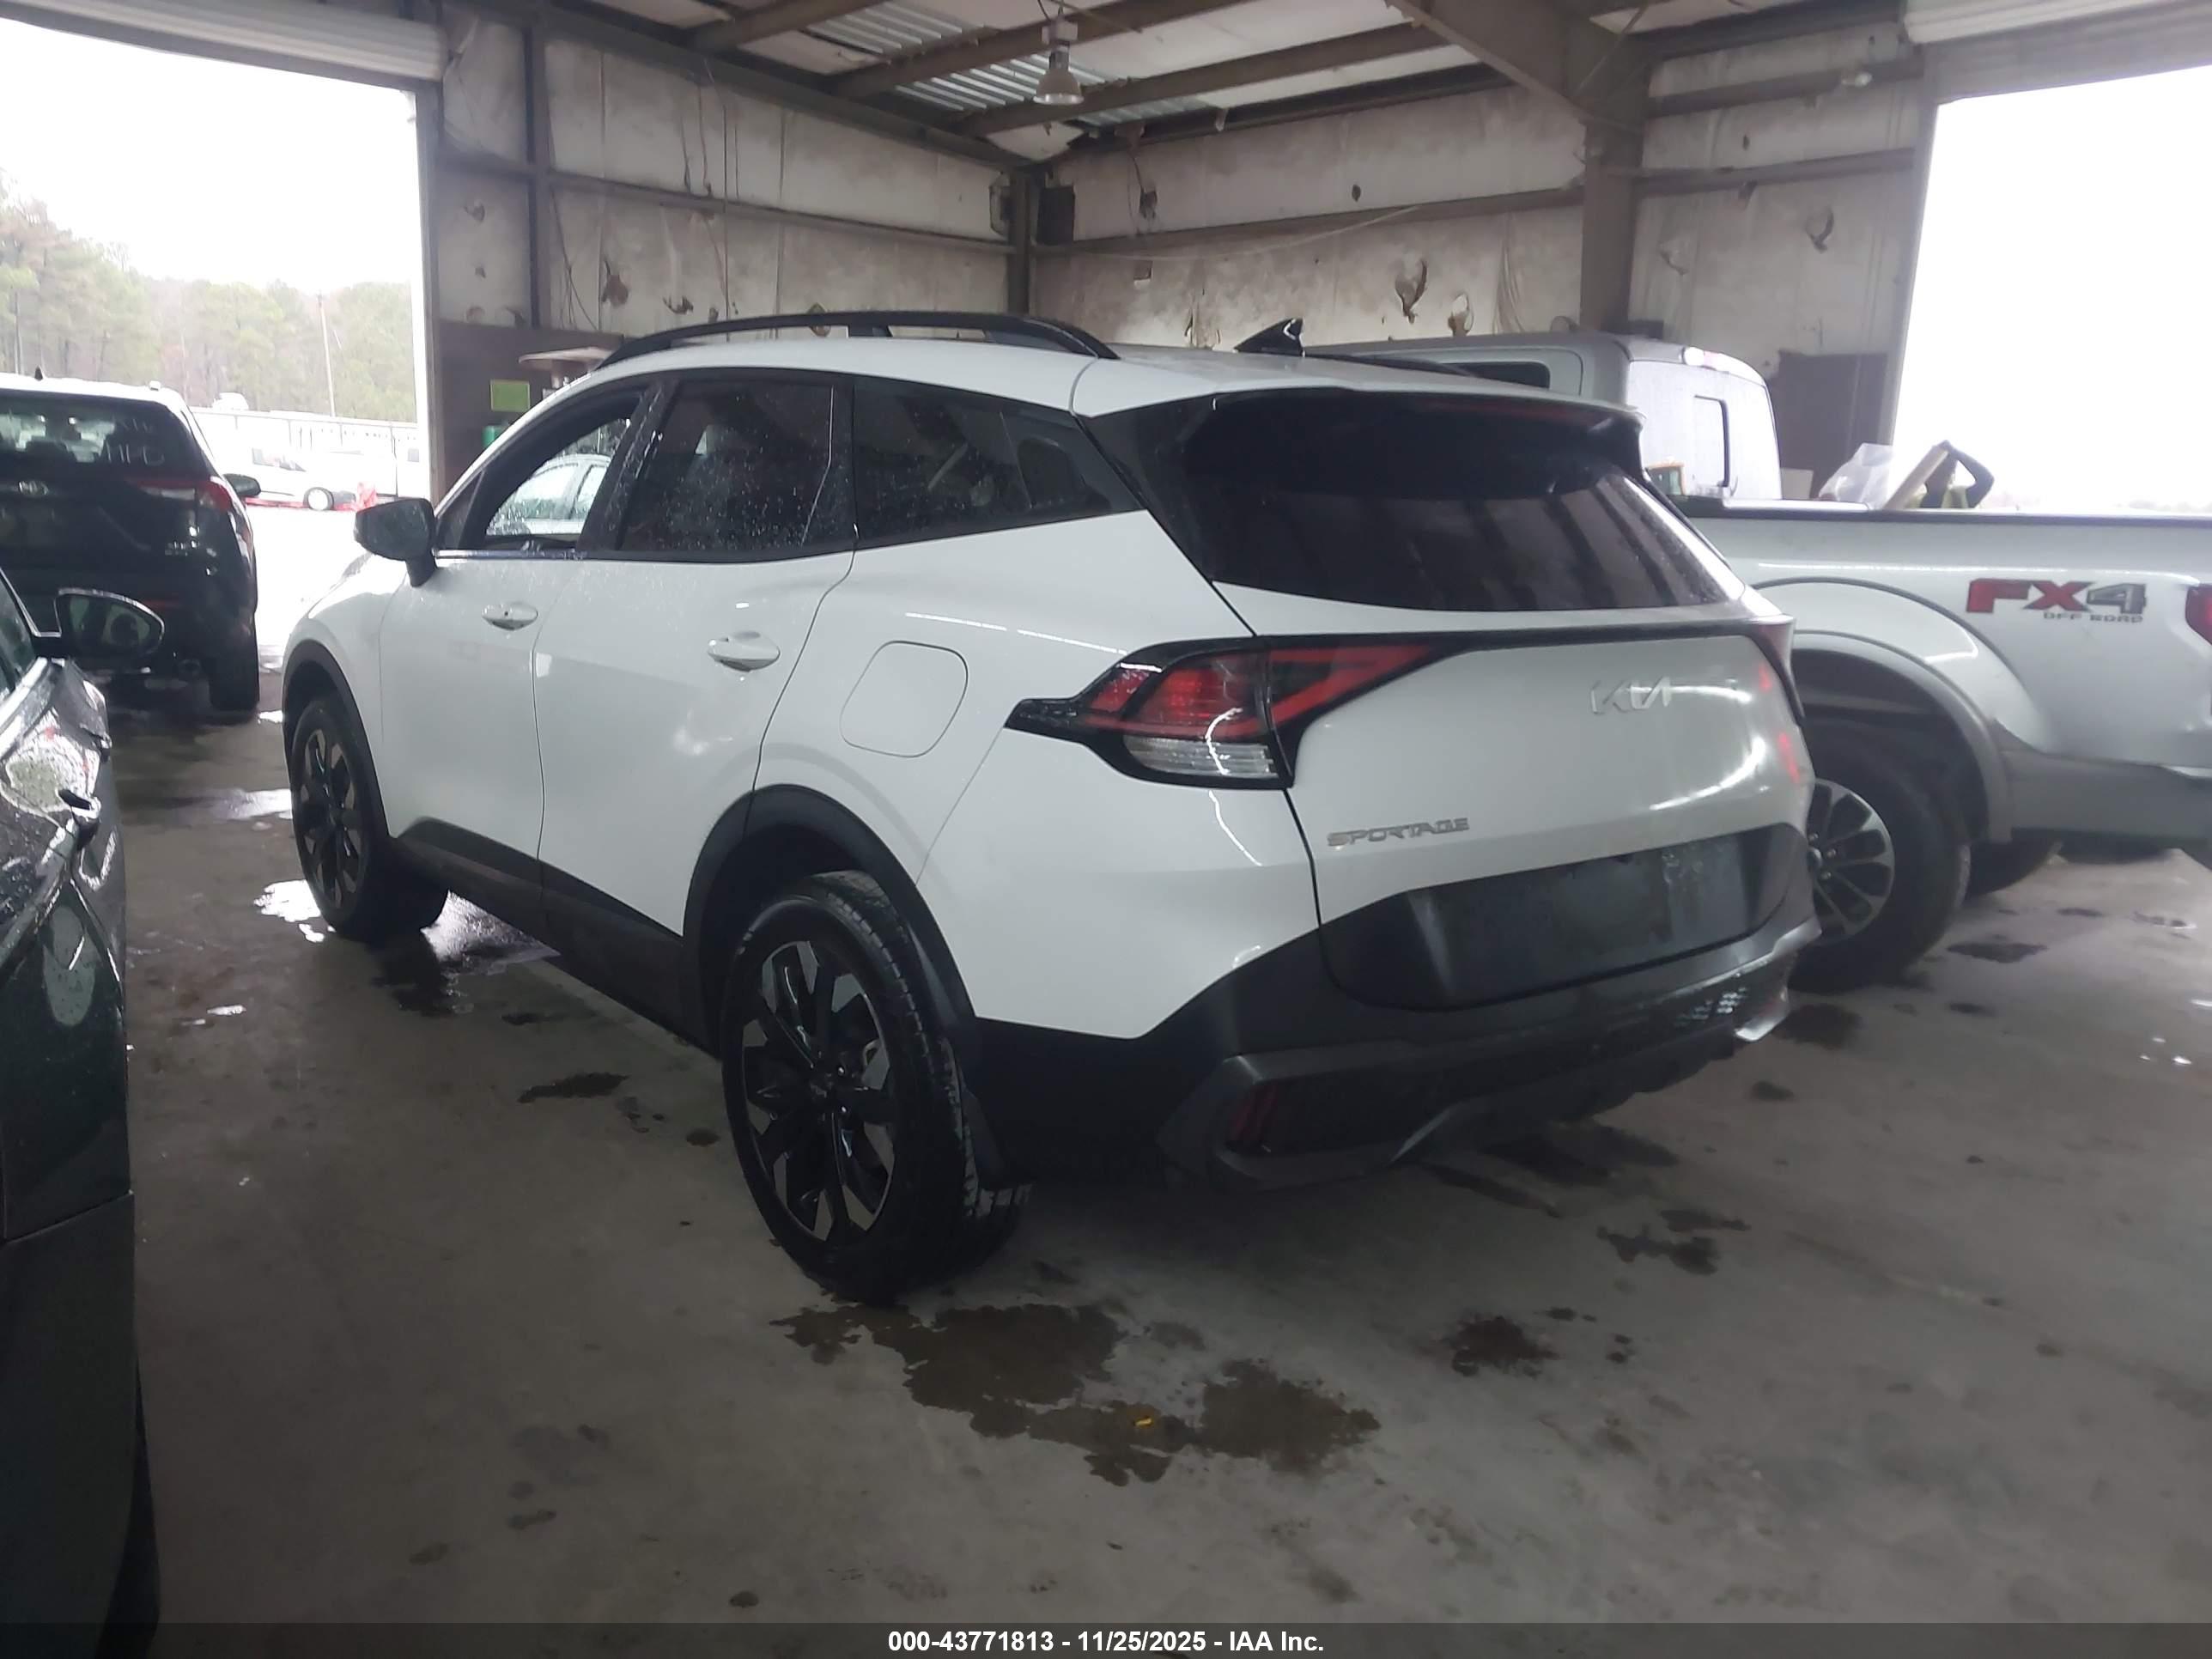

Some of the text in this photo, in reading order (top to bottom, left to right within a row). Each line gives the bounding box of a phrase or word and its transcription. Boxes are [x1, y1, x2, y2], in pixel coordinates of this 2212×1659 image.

[1966, 578, 2148, 615] FX4
[2044, 611, 2143, 623] OFF ROAD
[1590, 675, 1672, 715] KIA
[1327, 817, 1470, 847] SPORTAGE
